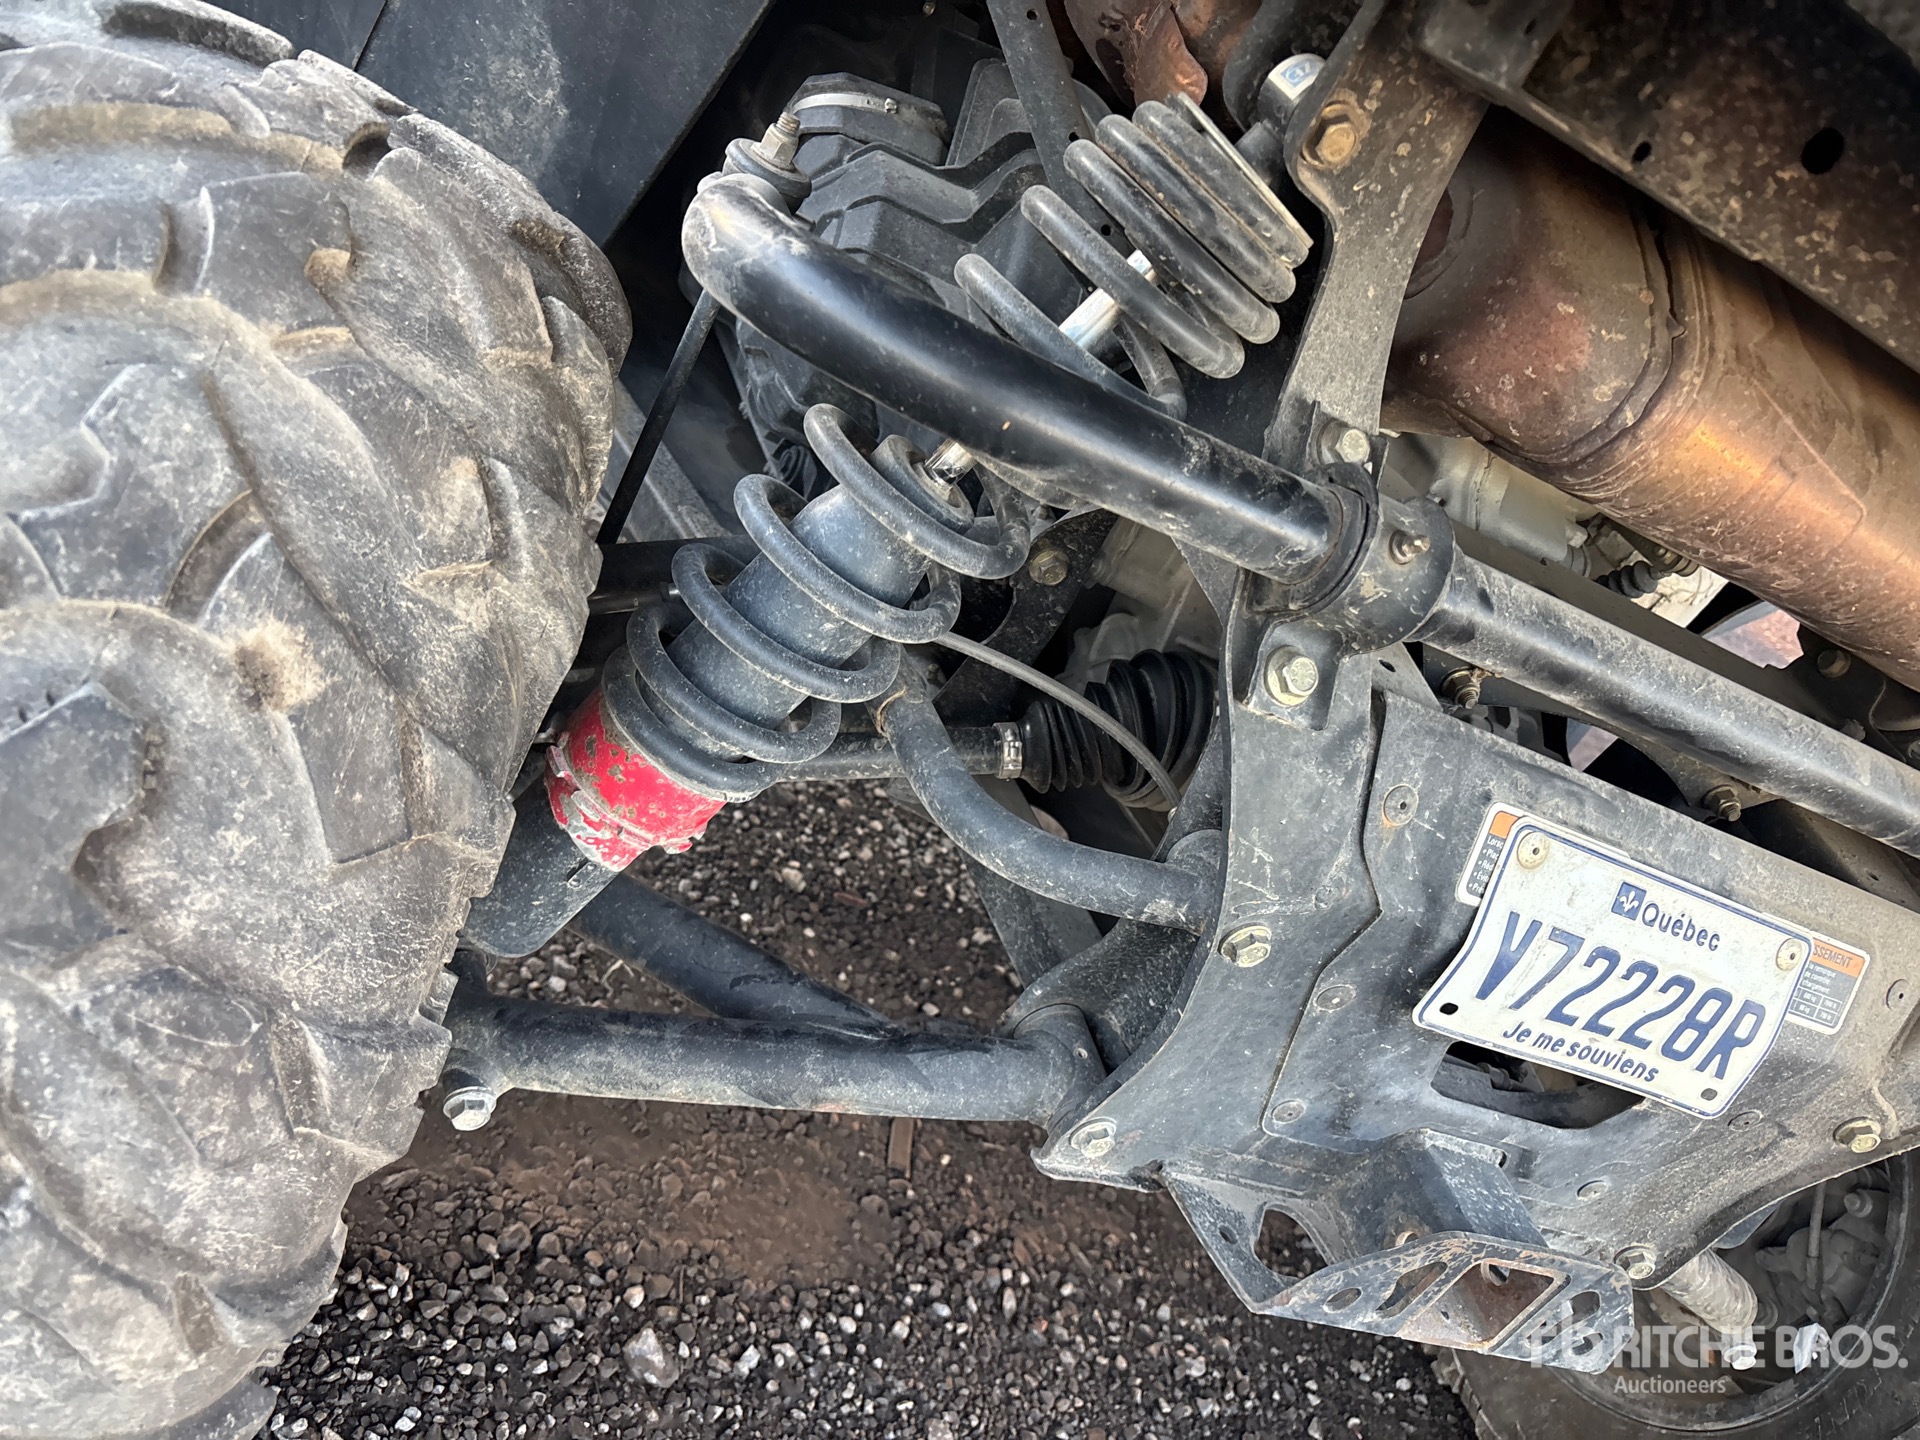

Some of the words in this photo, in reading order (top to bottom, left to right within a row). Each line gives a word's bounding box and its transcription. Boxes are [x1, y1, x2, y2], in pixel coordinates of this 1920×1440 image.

[1472, 883, 1484, 894] Pré
[1641, 902, 1721, 952] Québec
[1813, 944, 1853, 968] SSEMENT
[1475, 911, 1766, 1080] V72228R
[1502, 1021, 1531, 1043] Je
[1532, 1033, 1565, 1053] me
[1566, 1040, 1660, 1082] souviens
